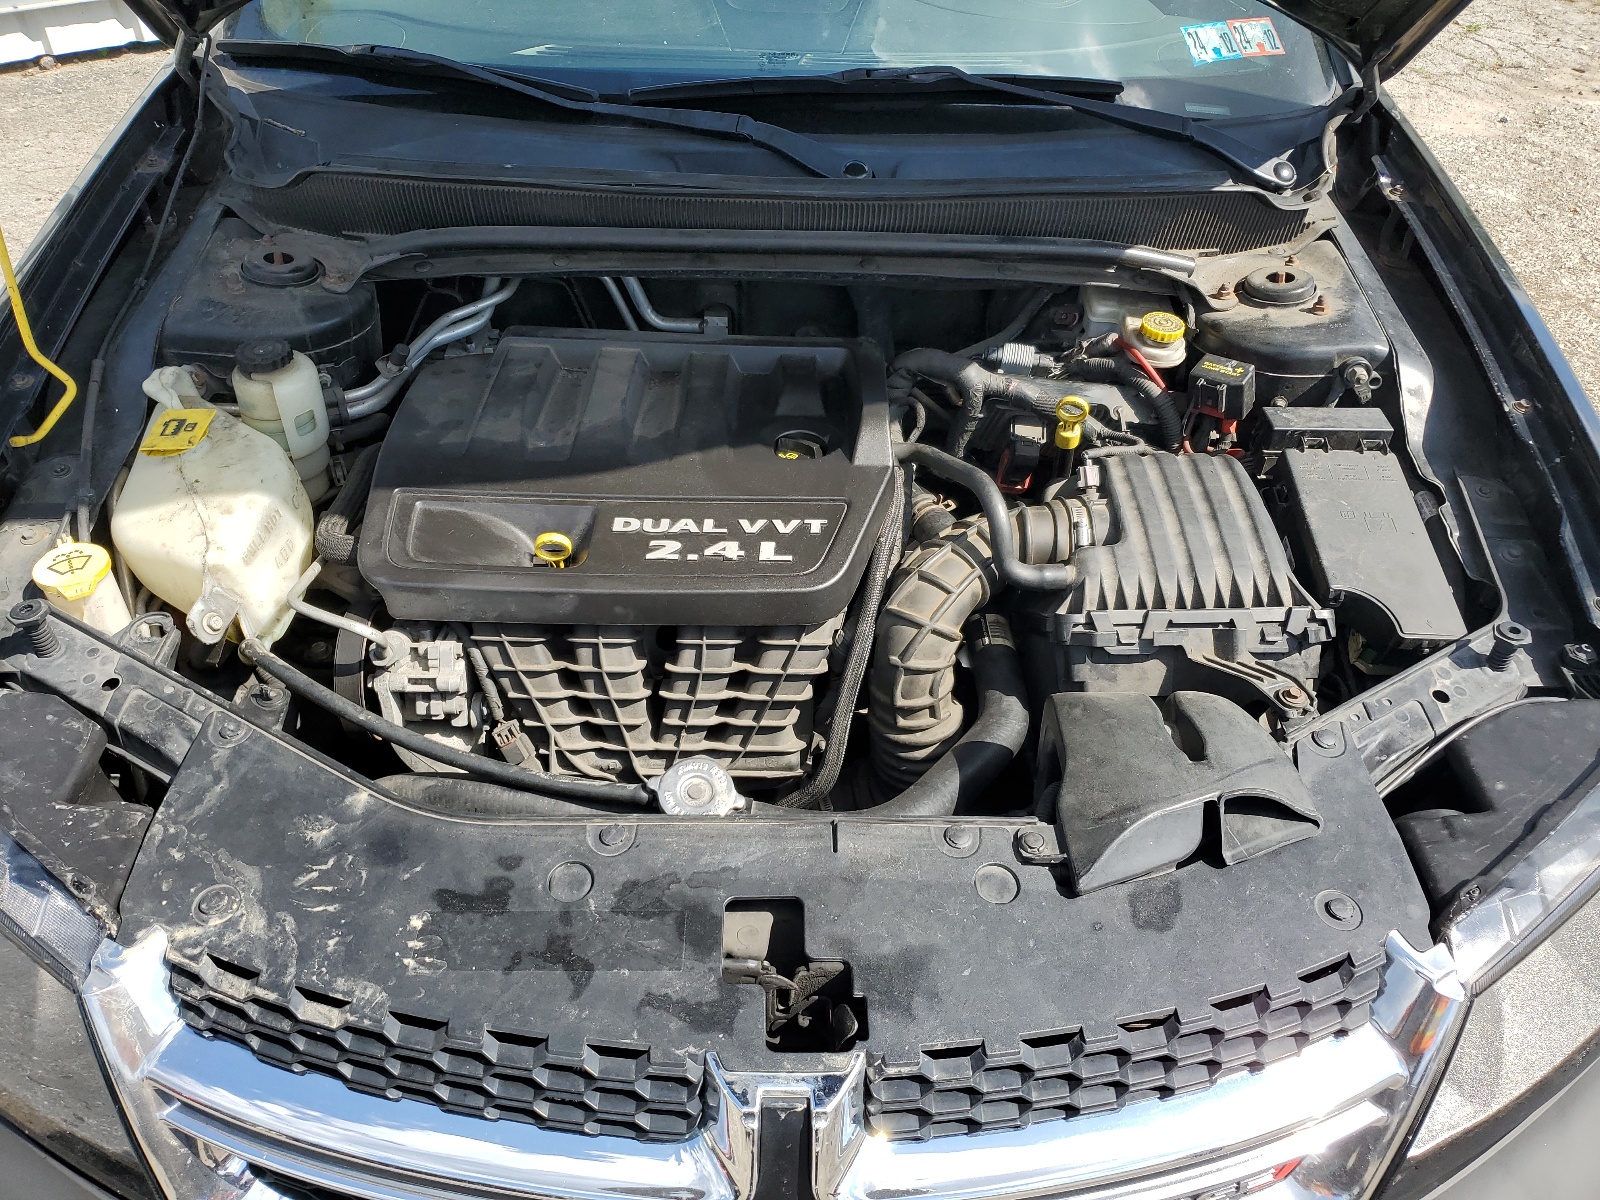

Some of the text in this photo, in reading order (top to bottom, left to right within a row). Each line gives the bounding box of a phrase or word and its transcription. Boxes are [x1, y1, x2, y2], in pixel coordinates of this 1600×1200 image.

[1187, 30, 1237, 55] 24 12
[1233, 24, 1280, 50] 24 12
[611, 517, 828, 534] DUAL VVT
[759, 541, 793, 562] L
